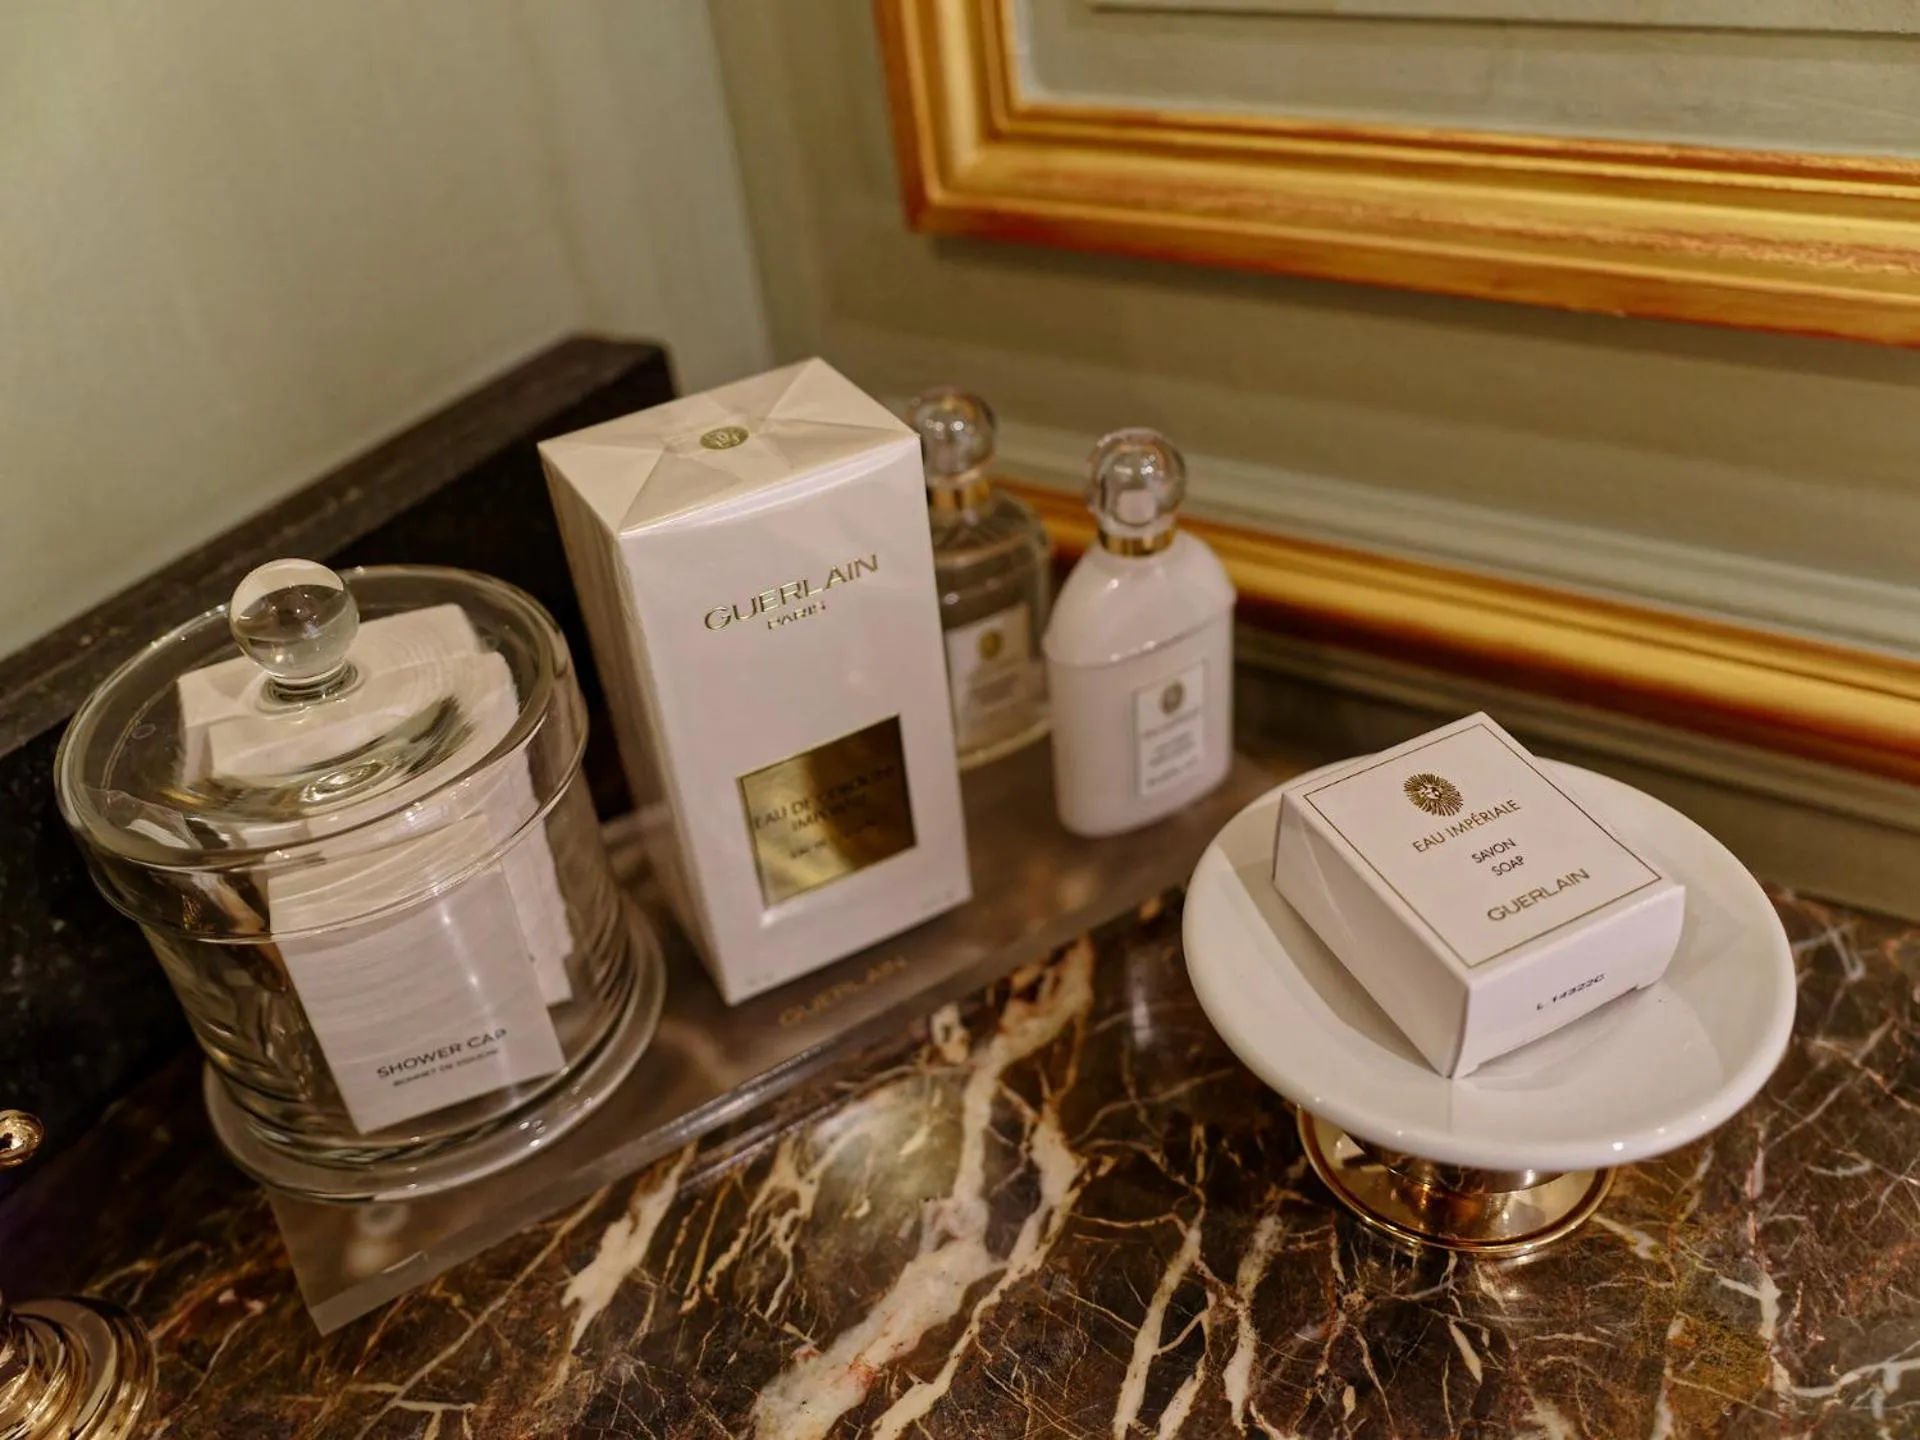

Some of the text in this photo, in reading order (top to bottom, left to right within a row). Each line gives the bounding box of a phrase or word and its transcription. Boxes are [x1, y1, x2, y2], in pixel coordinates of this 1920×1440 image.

[704, 554, 878, 631] GUERLAIN
[1412, 799, 1521, 853] EAU IMPÉRIALE
[1471, 838, 1517, 864] SAVON
[1491, 855, 1524, 876] SOAP
[1487, 868, 1590, 921] GUERLAIN
[377, 1043, 462, 1078] SHOWER
[466, 1028, 507, 1048] CAP
